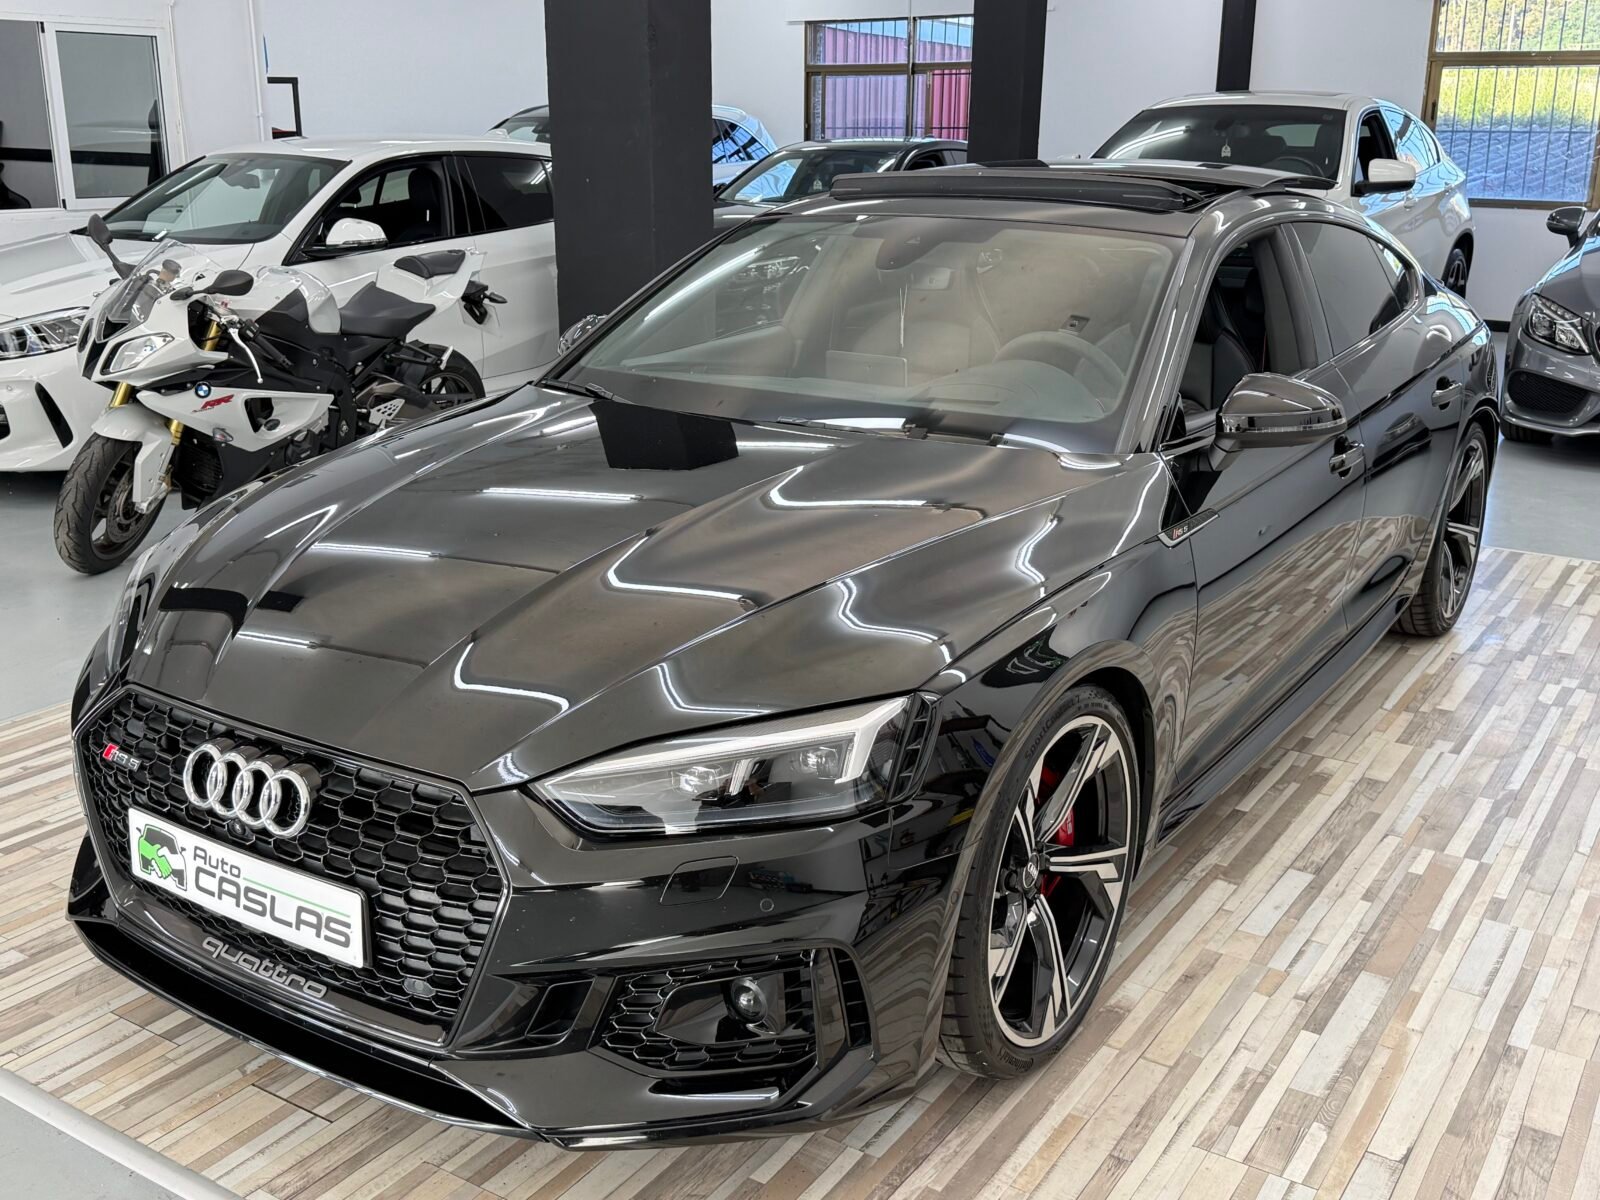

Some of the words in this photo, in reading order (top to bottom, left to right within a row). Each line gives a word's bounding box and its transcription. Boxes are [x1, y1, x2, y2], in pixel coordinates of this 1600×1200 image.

[1025, 697, 1075, 760] SportCont
[193, 845, 241, 879] Auto
[195, 866, 352, 949] CASLAS
[202, 936, 328, 999] quattro
